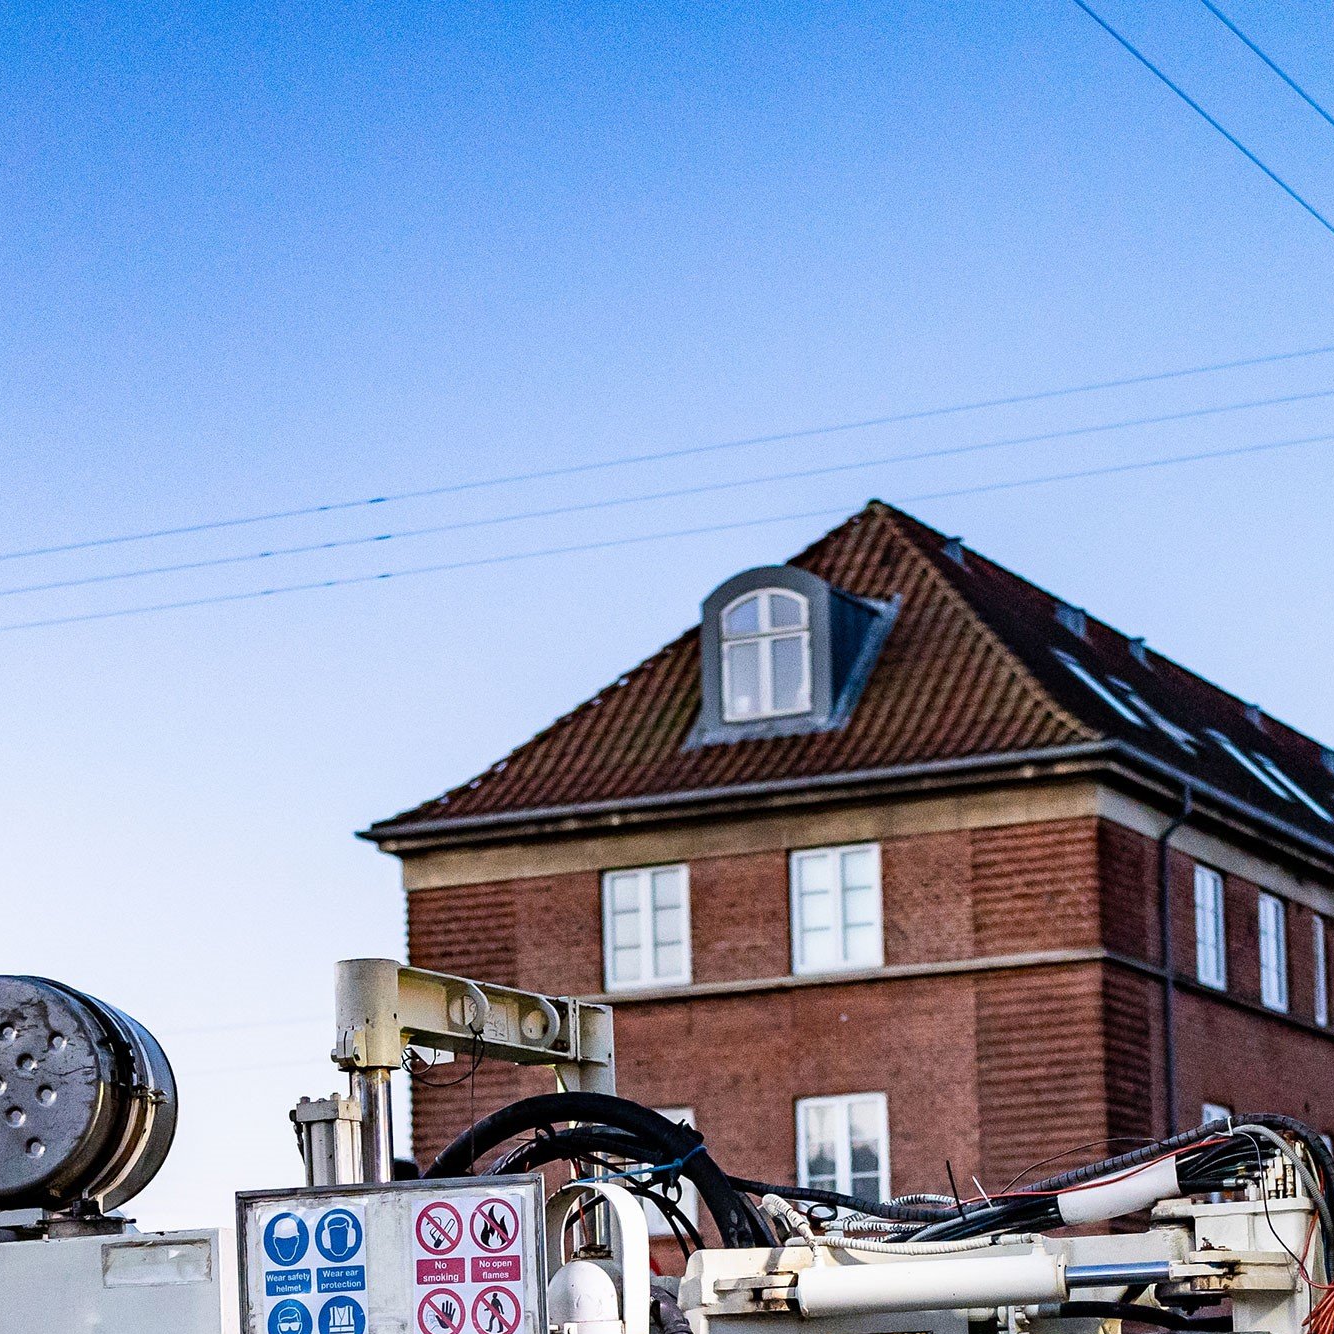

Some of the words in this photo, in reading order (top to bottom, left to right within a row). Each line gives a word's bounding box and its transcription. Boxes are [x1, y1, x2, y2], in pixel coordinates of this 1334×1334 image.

[434, 1261, 447, 1269] No
[479, 1260, 491, 1268] No
[492, 1260, 512, 1269] open
[266, 1274, 286, 1282] Wear
[287, 1273, 310, 1282] safety
[322, 1270, 344, 1278] Wear
[345, 1269, 359, 1277] ear
[423, 1273, 459, 1282] smoking
[482, 1271, 509, 1279] flames
[276, 1284, 302, 1293] helmet
[321, 1280, 362, 1290] protection
